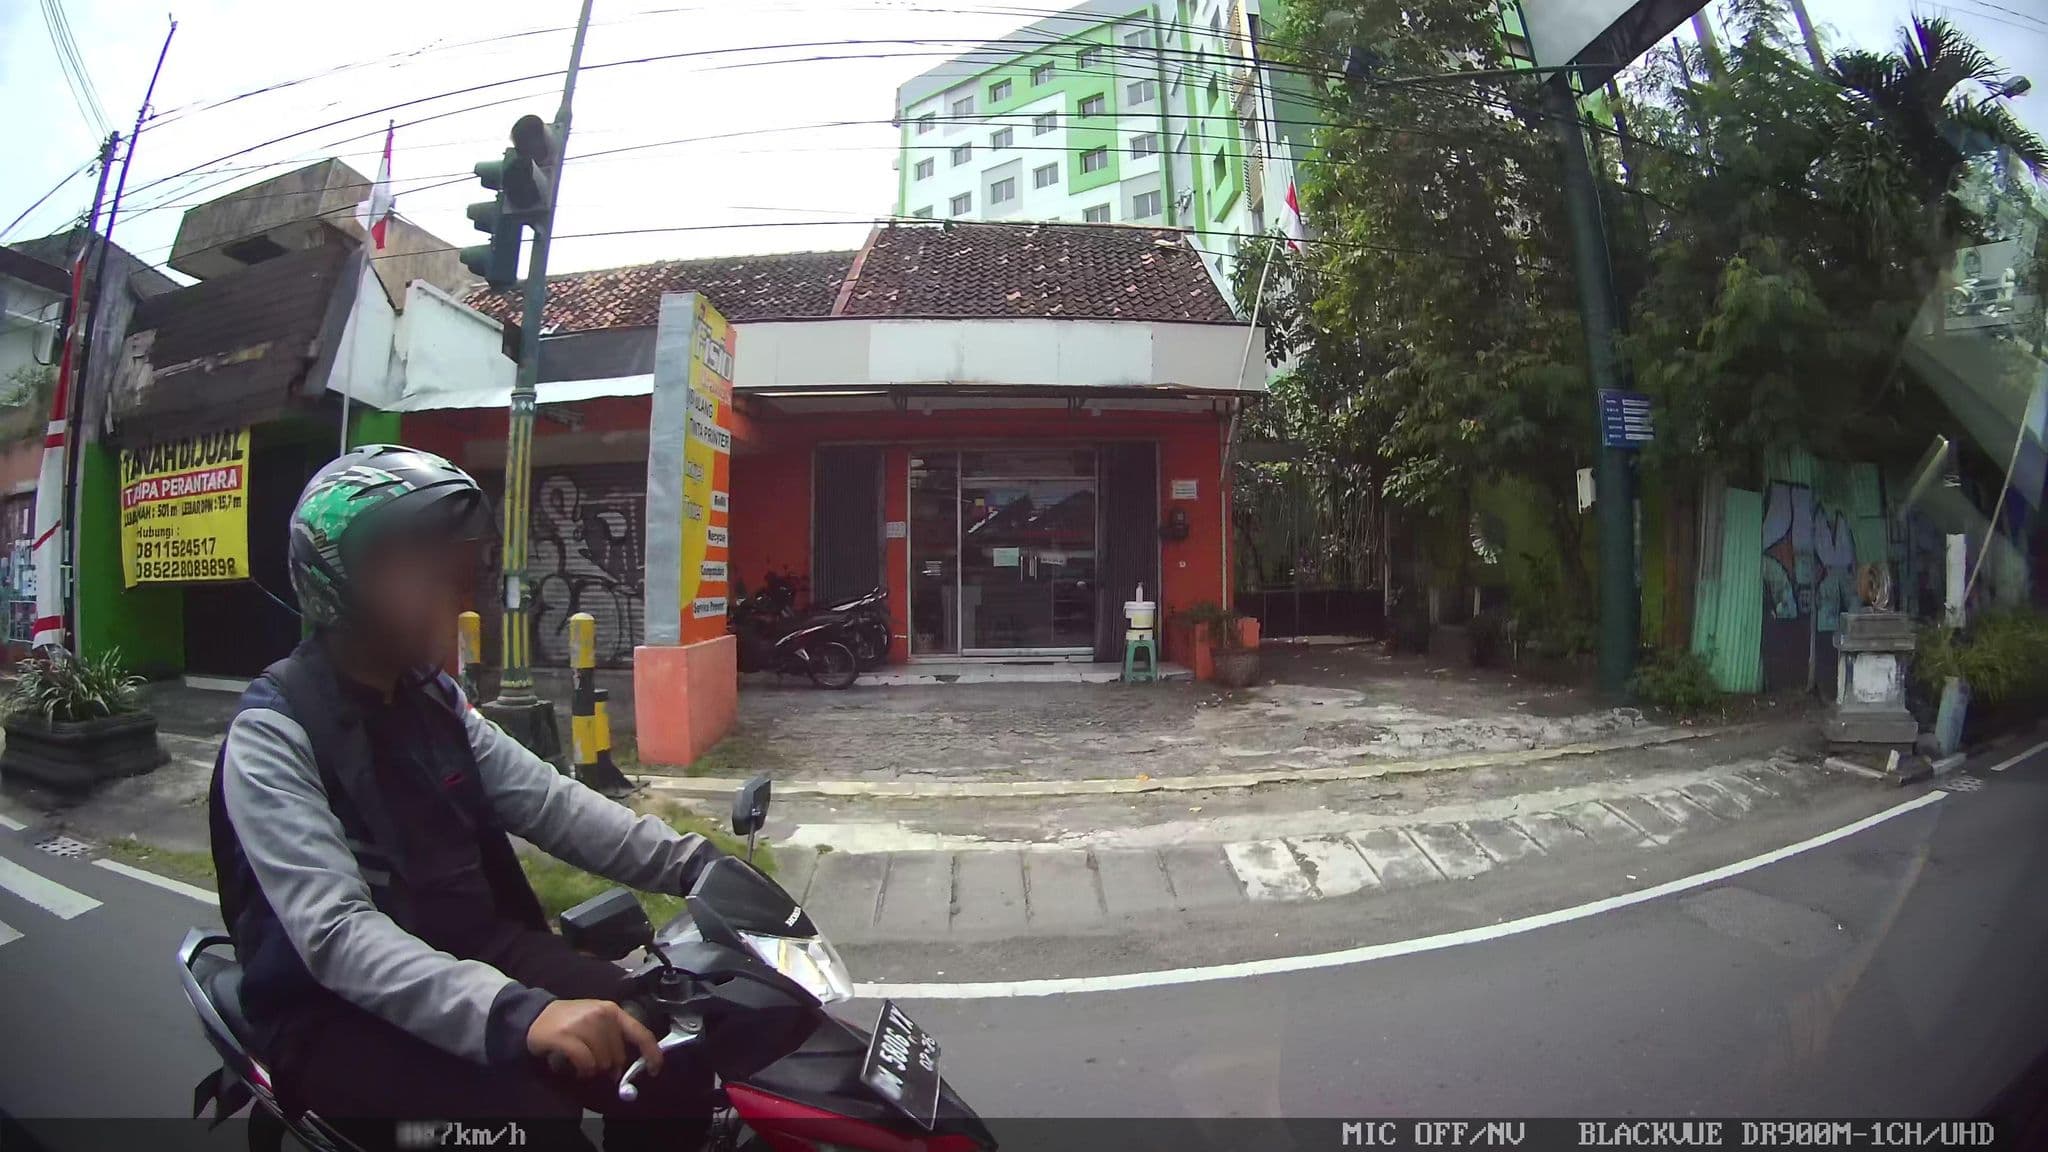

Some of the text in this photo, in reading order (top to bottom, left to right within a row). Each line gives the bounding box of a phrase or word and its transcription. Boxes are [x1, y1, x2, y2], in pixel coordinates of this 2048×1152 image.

[704, 426, 729, 448] PRINTER
[179, 430, 244, 470] DIJUAL
[162, 469, 238, 497] PERANTARA
[137, 524, 174, 539] Hubungi
[136, 537, 216, 559] 0811524517
[879, 1027, 911, 1071] 5806
